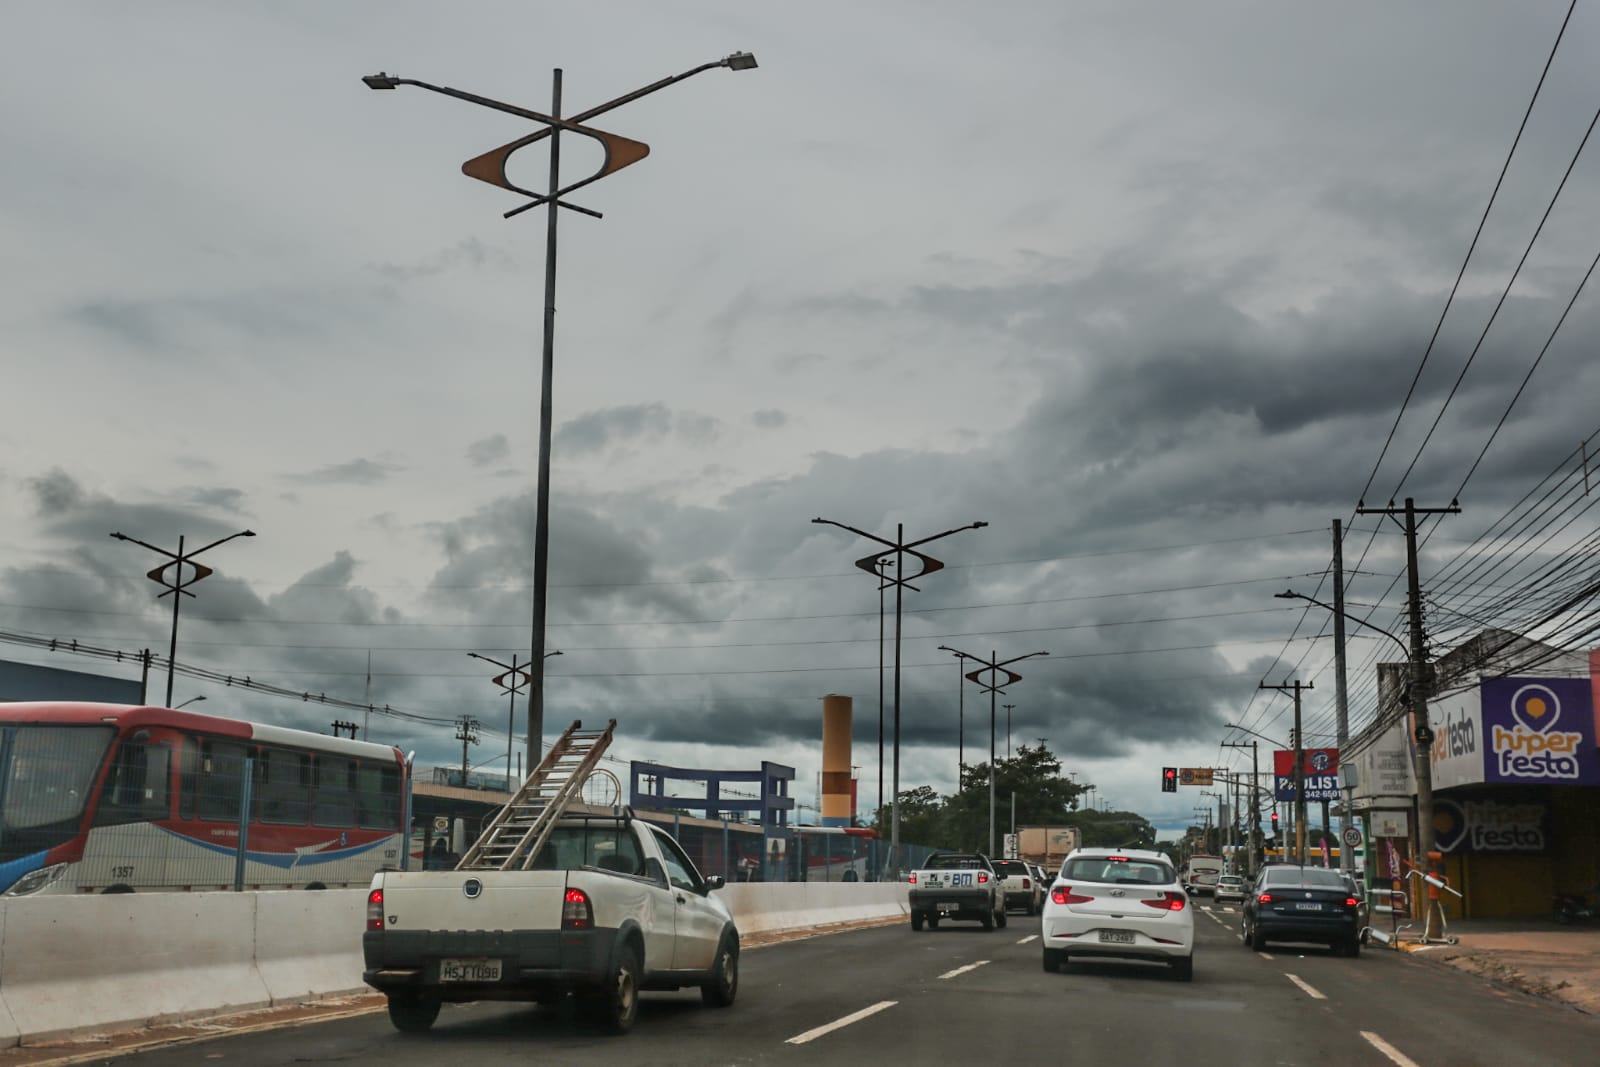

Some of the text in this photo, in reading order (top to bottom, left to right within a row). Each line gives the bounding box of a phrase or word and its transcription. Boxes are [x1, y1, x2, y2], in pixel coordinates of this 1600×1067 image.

[1494, 726, 1580, 757] hiper
[1500, 749, 1576, 775] festa
[1347, 832, 1359, 841] 50
[1473, 823, 1542, 846] festa
[111, 865, 135, 878] 1357
